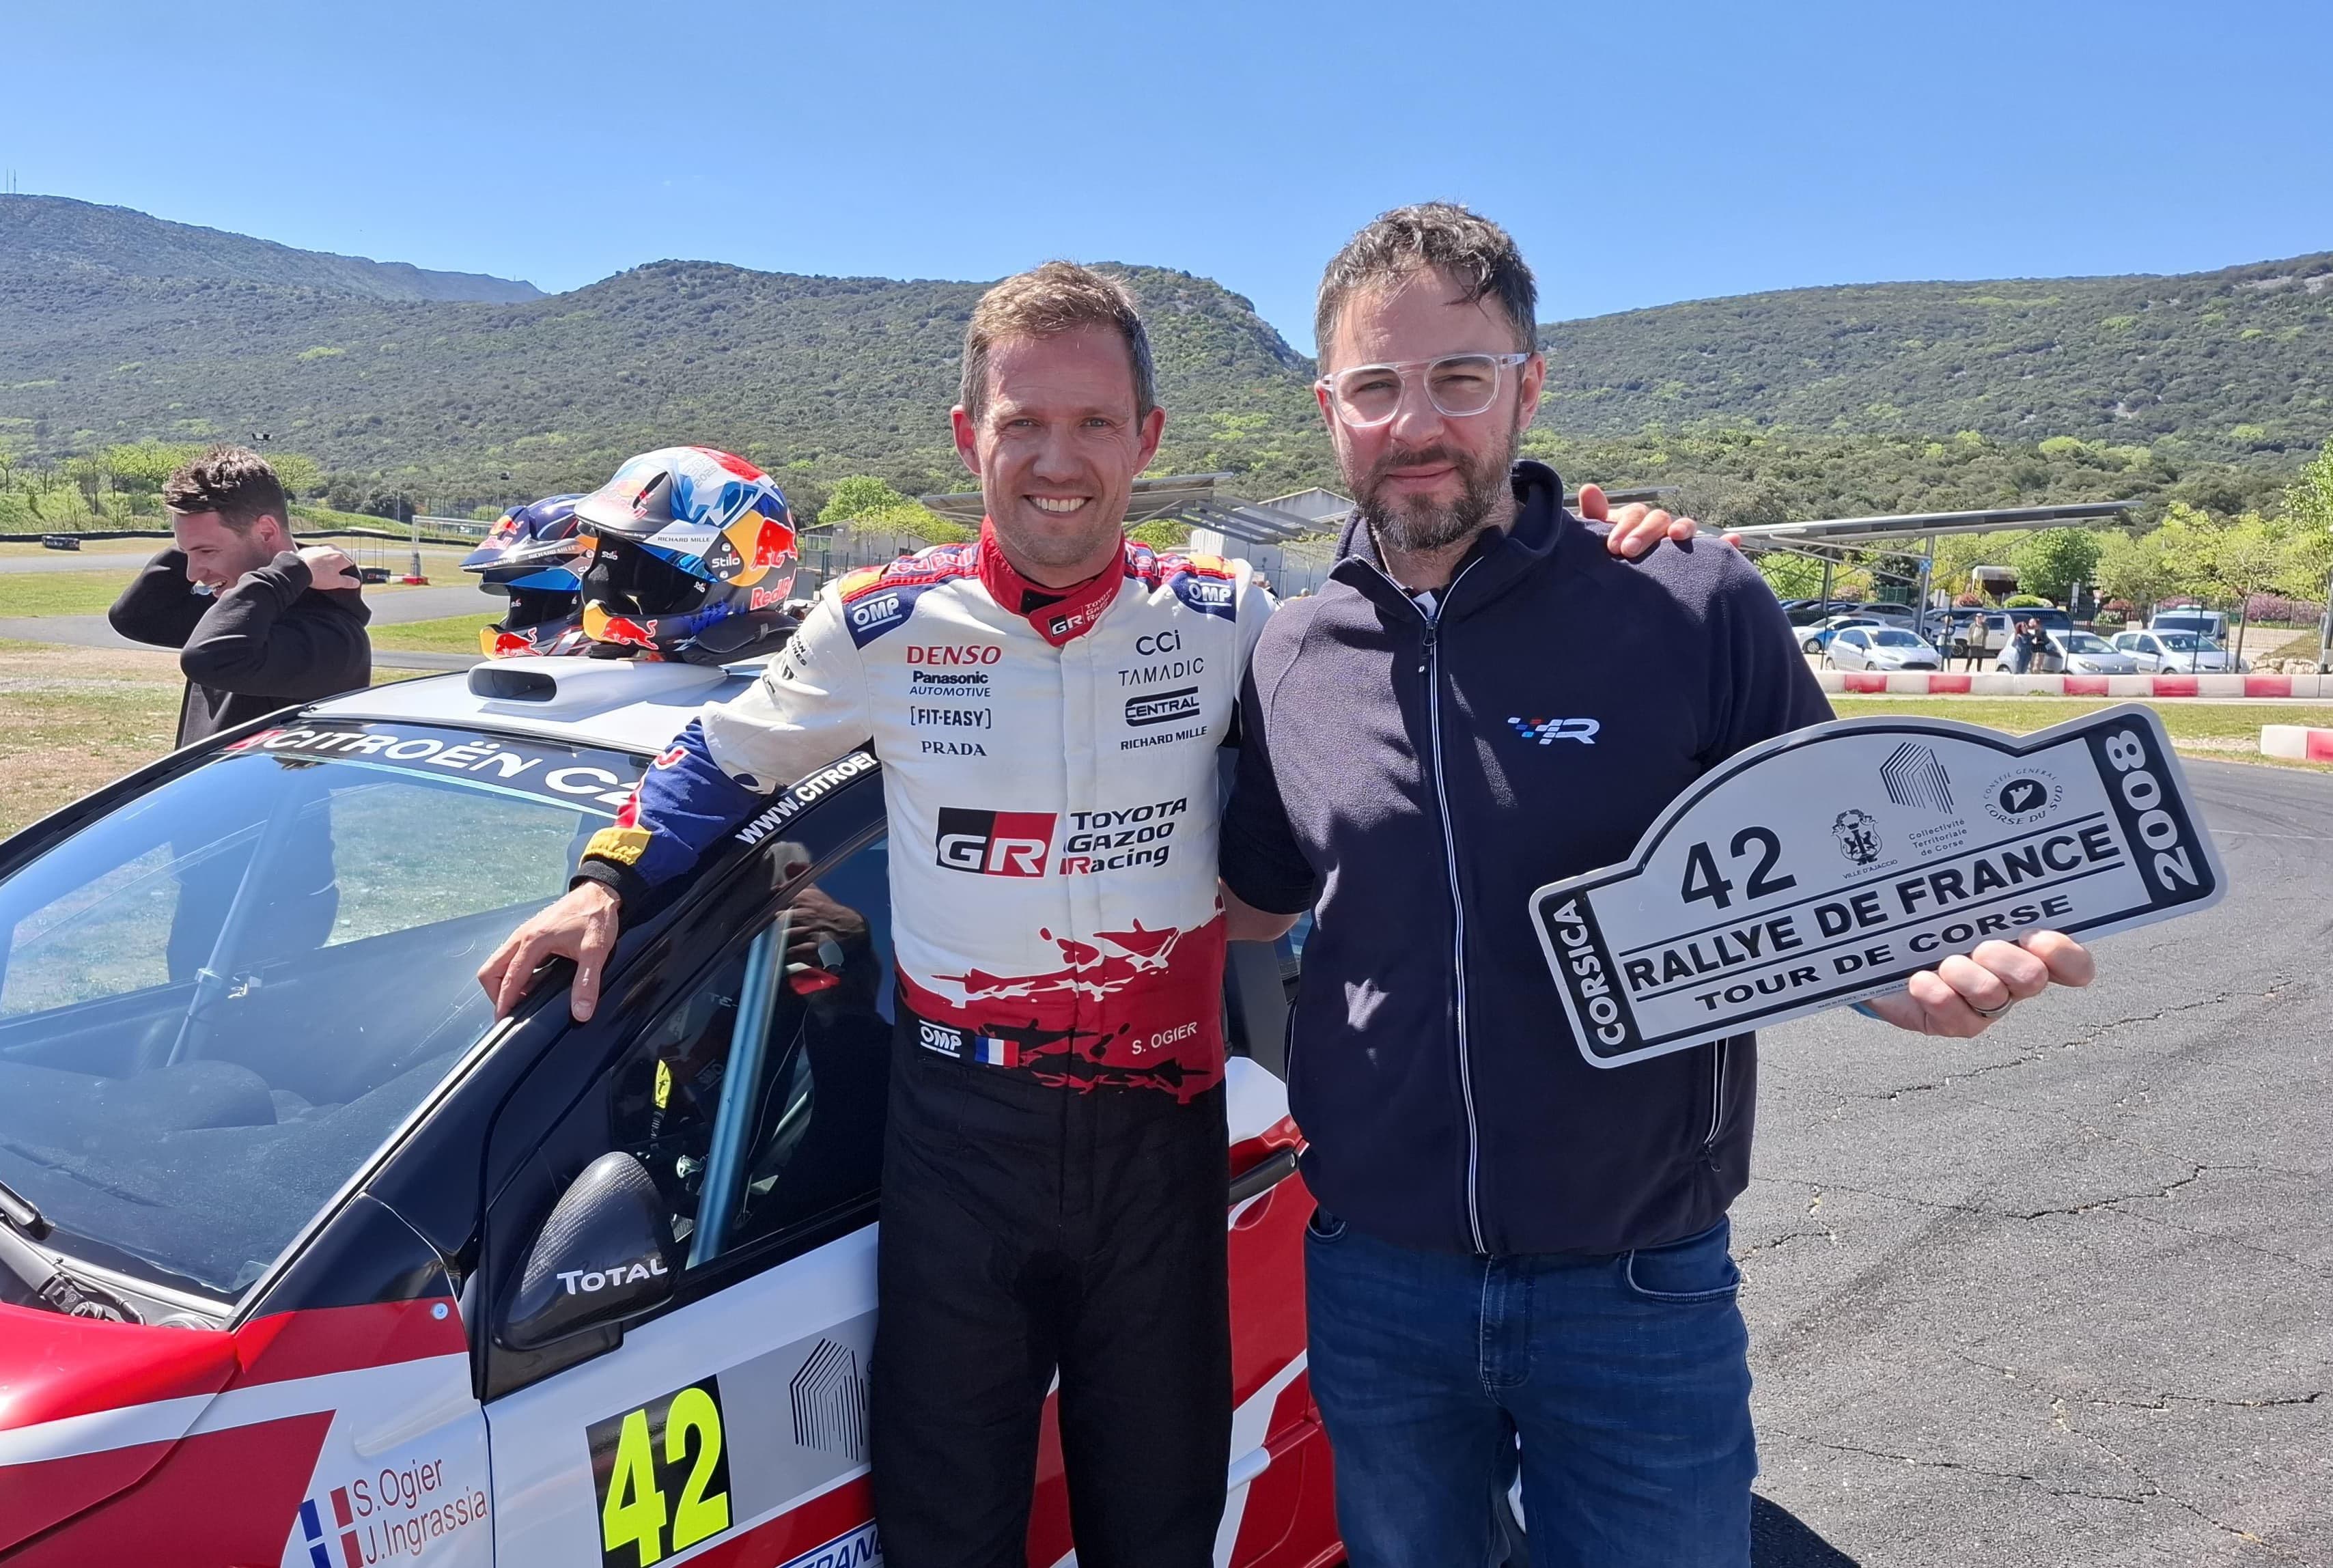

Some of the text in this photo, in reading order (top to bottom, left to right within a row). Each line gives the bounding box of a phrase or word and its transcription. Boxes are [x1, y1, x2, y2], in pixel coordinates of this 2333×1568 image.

[712, 550, 740, 568] Stilo
[1188, 583, 1231, 602] OMP
[854, 597, 899, 625] OMP
[1052, 615, 1083, 634] GR
[907, 645, 1002, 665] DENSO
[913, 671, 989, 684] Panasonic
[1118, 658, 1204, 686] TAMADIC
[910, 686, 991, 697] AUTOMOTIVE
[1126, 697, 1199, 718] CENTRAL
[921, 740, 988, 757] PRADA
[1121, 726, 1207, 751] RICHARD MILLE
[263, 730, 543, 778] CITROËN
[1070, 797, 1188, 831] TOYOTA
[1985, 785, 2063, 825] CORSE DU SUD
[2106, 730, 2199, 891] 2008
[1064, 822, 1175, 854] GAZOO
[1909, 818, 1965, 841] Collectivité
[1913, 828, 1968, 849] Territoriale
[939, 834, 1046, 875] GR
[1059, 845, 1170, 876] Racing
[1920, 839, 1964, 856] de Corse
[1681, 826, 1798, 910] 42
[1843, 869, 1862, 880] VILLE
[1623, 823, 2121, 992] RALLYE DE FRANCE
[1694, 895, 2073, 1011] TOUR DE CORSE
[1553, 898, 1625, 1046] CORSICA
[921, 1026, 962, 1051] OMP
[1132, 1022, 1197, 1055] S. OGIER
[557, 1259, 668, 1295] TOTAL
[353, 1459, 442, 1517] S.Ogier
[603, 1388, 729, 1567] 42
[366, 1485, 488, 1565] J.Ingrassia
